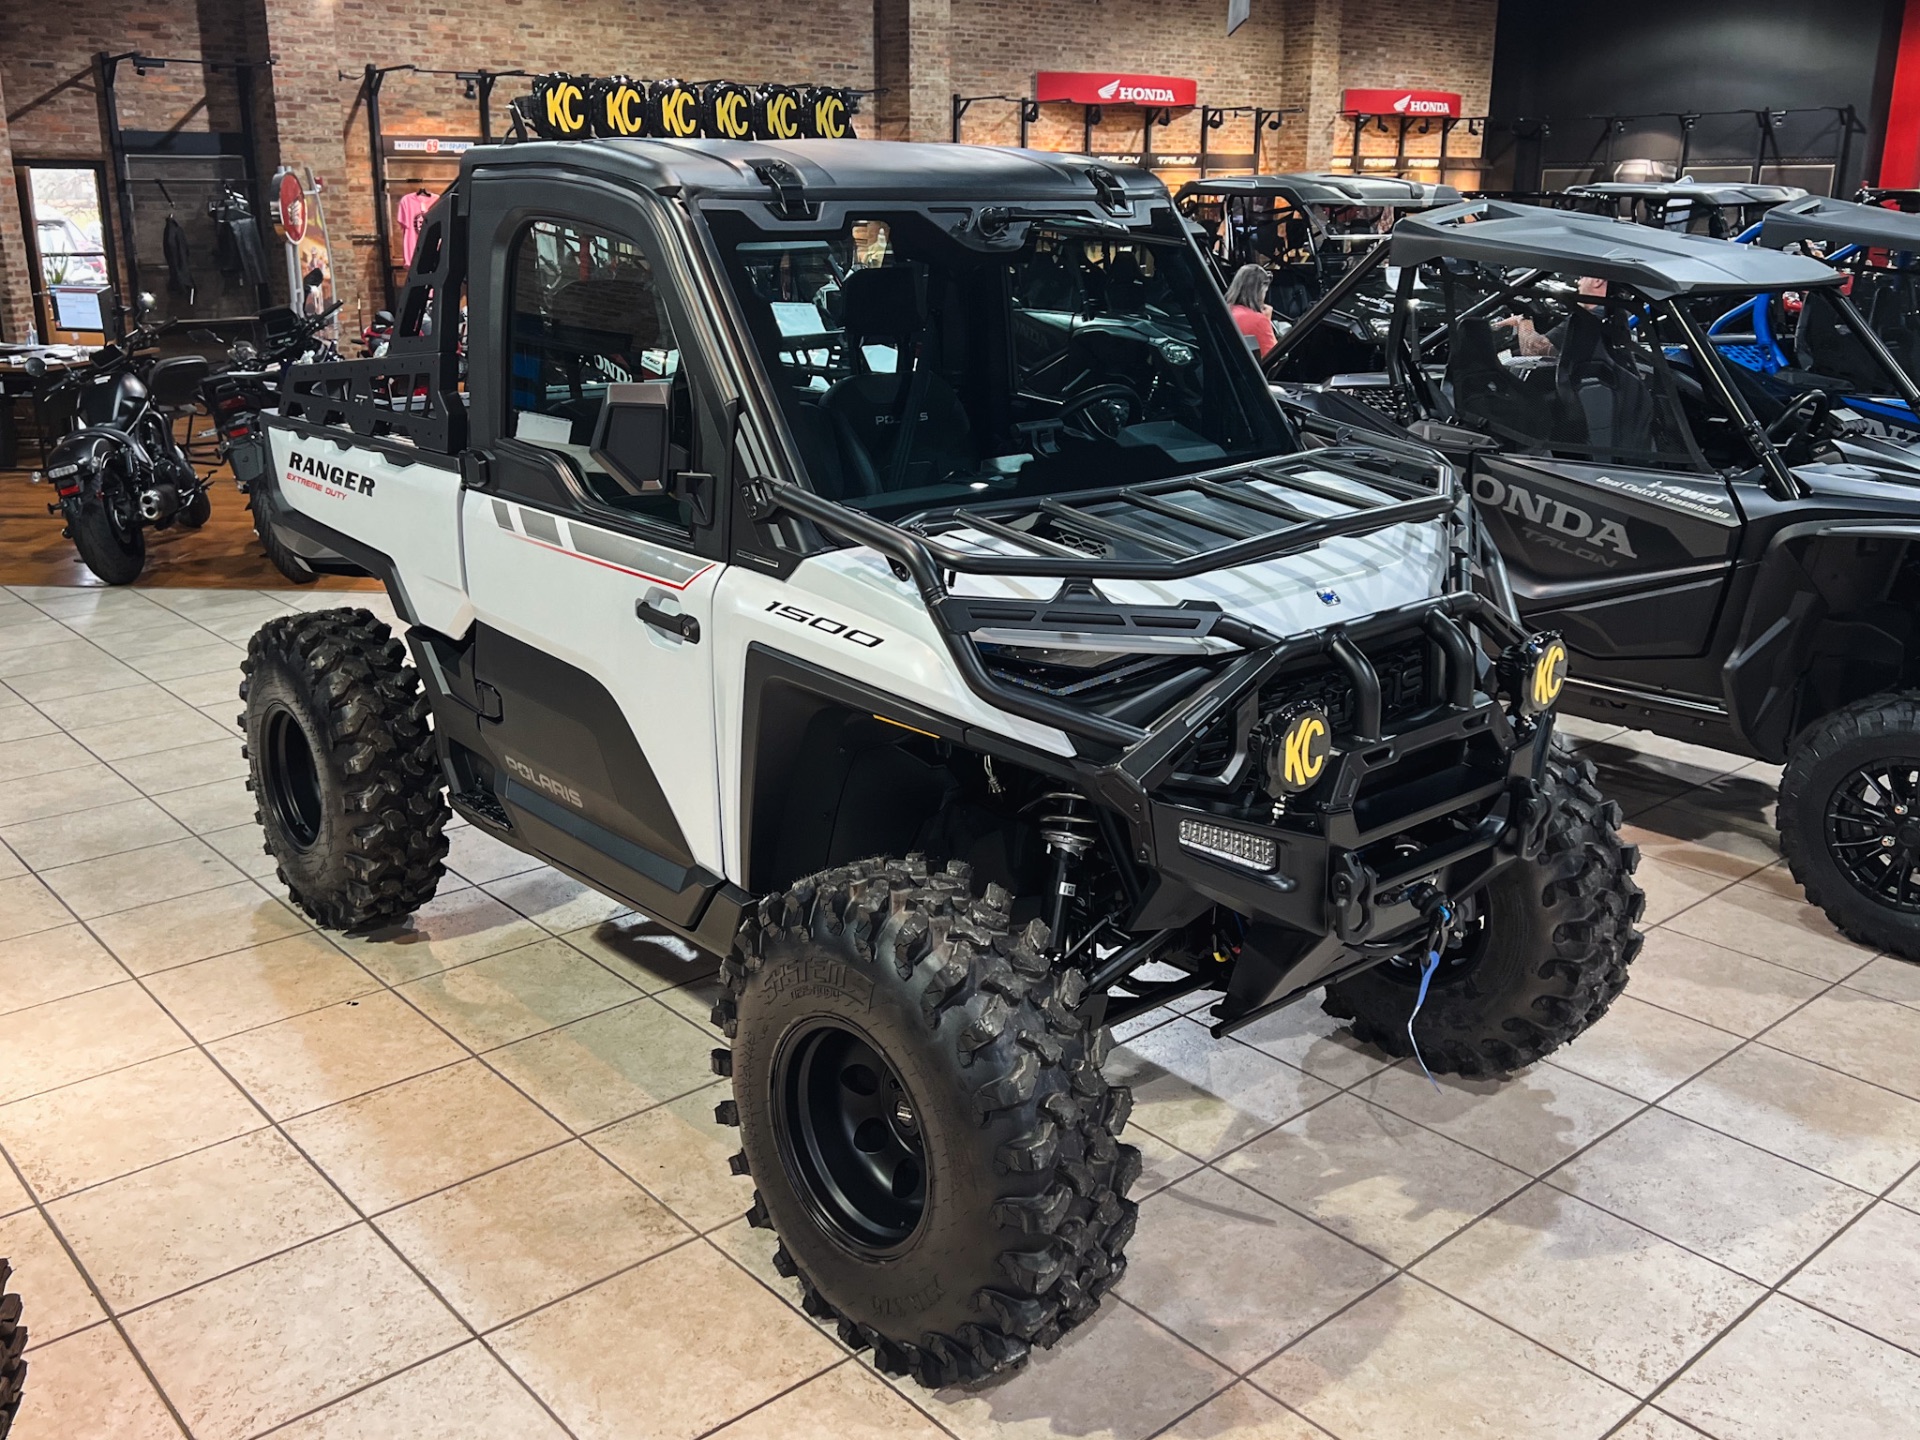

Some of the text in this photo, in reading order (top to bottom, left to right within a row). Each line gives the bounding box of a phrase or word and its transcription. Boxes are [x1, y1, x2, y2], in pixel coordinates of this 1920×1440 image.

[546, 82, 584, 133] KC
[606, 86, 642, 135] KC
[662, 89, 697, 137] KC
[716, 91, 748, 139] KC
[767, 93, 797, 139] KC
[815, 95, 845, 139] KC
[1118, 87, 1175, 102] HONDA
[1410, 100, 1450, 113] HONDA
[426, 140, 438, 151] 69
[1157, 156, 1197, 165] TALON
[286, 472, 347, 501] EXTREME DUTY
[289, 451, 376, 498] RANGER
[1596, 476, 1731, 519] Dual Clutch Transmission
[1648, 480, 1724, 505] i-4WD
[1453, 463, 1638, 560] ONDA
[1521, 526, 1619, 569] TALON
[764, 600, 885, 648] 1500
[1534, 645, 1565, 705] KC
[1284, 717, 1325, 786] KC
[505, 754, 583, 809] POLARIS
